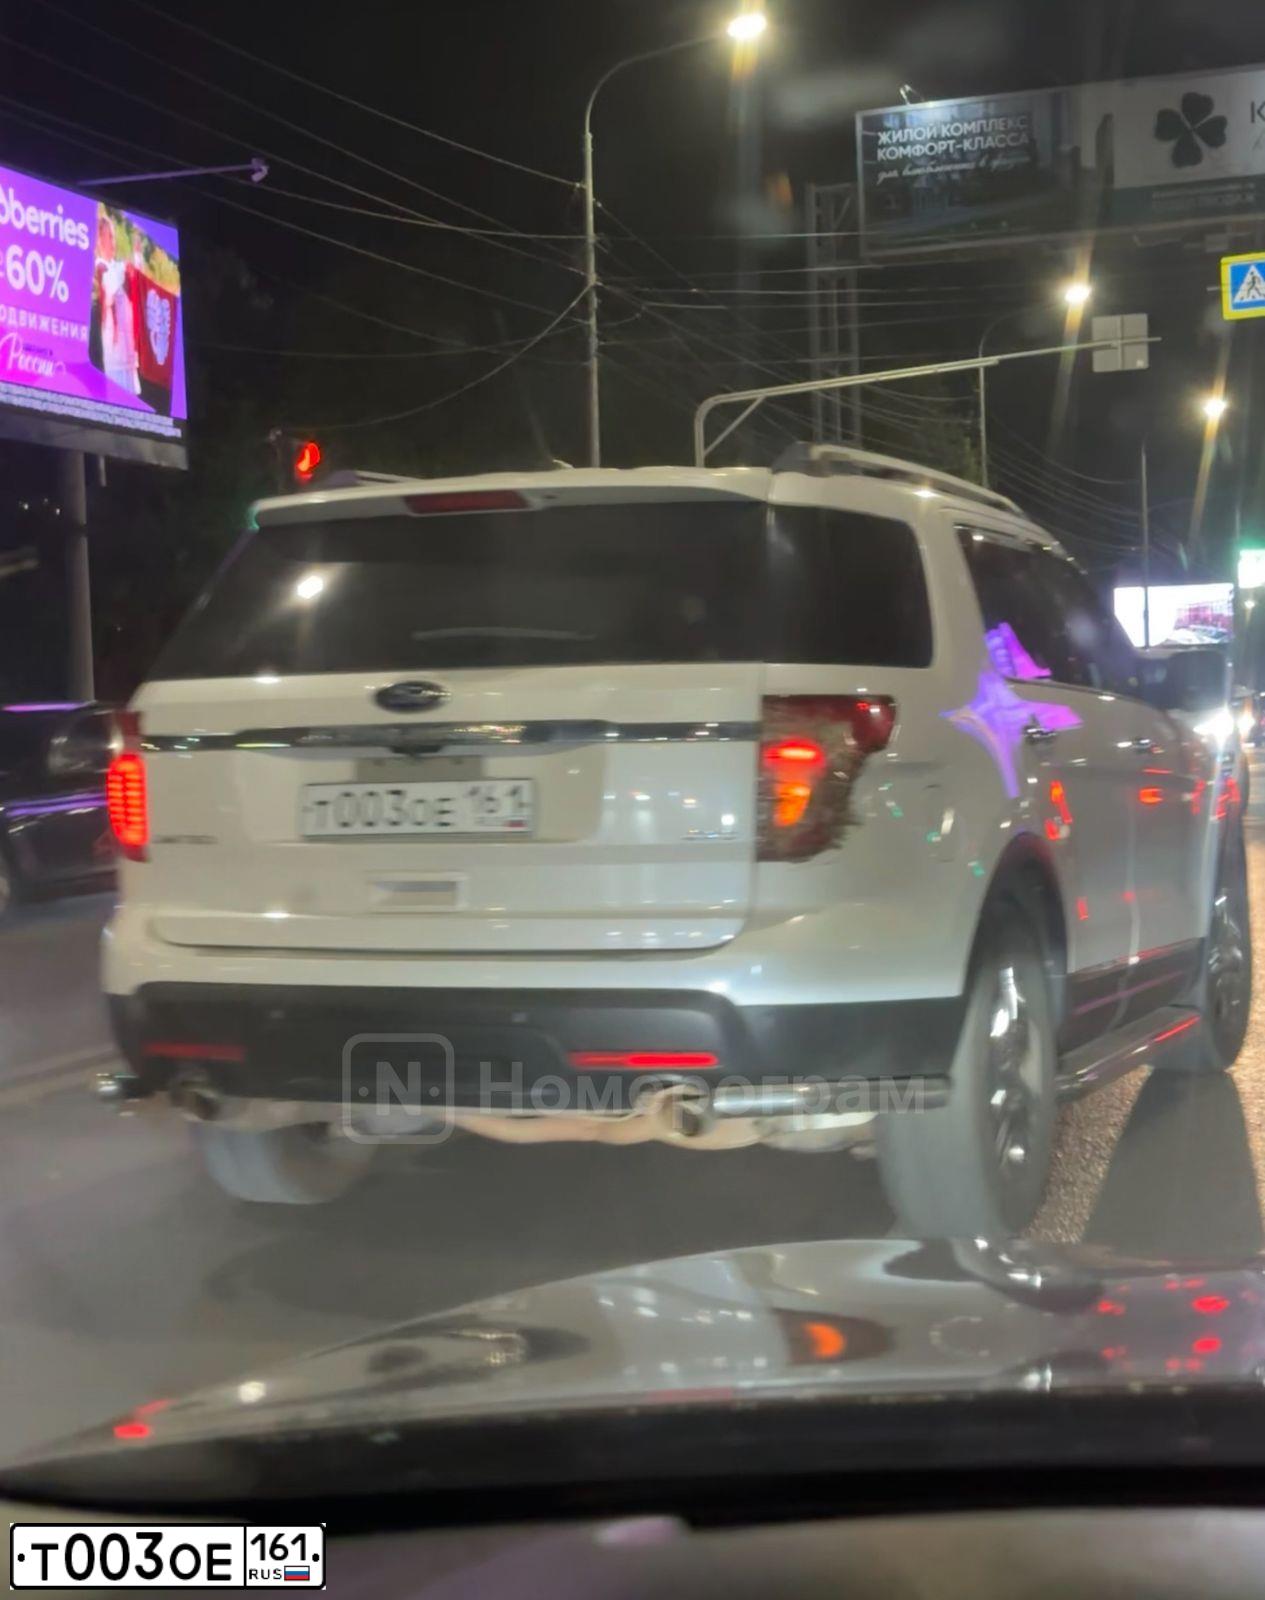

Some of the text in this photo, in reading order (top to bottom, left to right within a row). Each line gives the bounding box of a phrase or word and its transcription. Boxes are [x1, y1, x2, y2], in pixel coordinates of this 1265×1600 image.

[878, 116, 1028, 145] ЖИЛОЙ КОМПЛЕКС
[877, 132, 1029, 161] КОМФОРТ-КЛАССА
[6, 244, 69, 303] 60%
